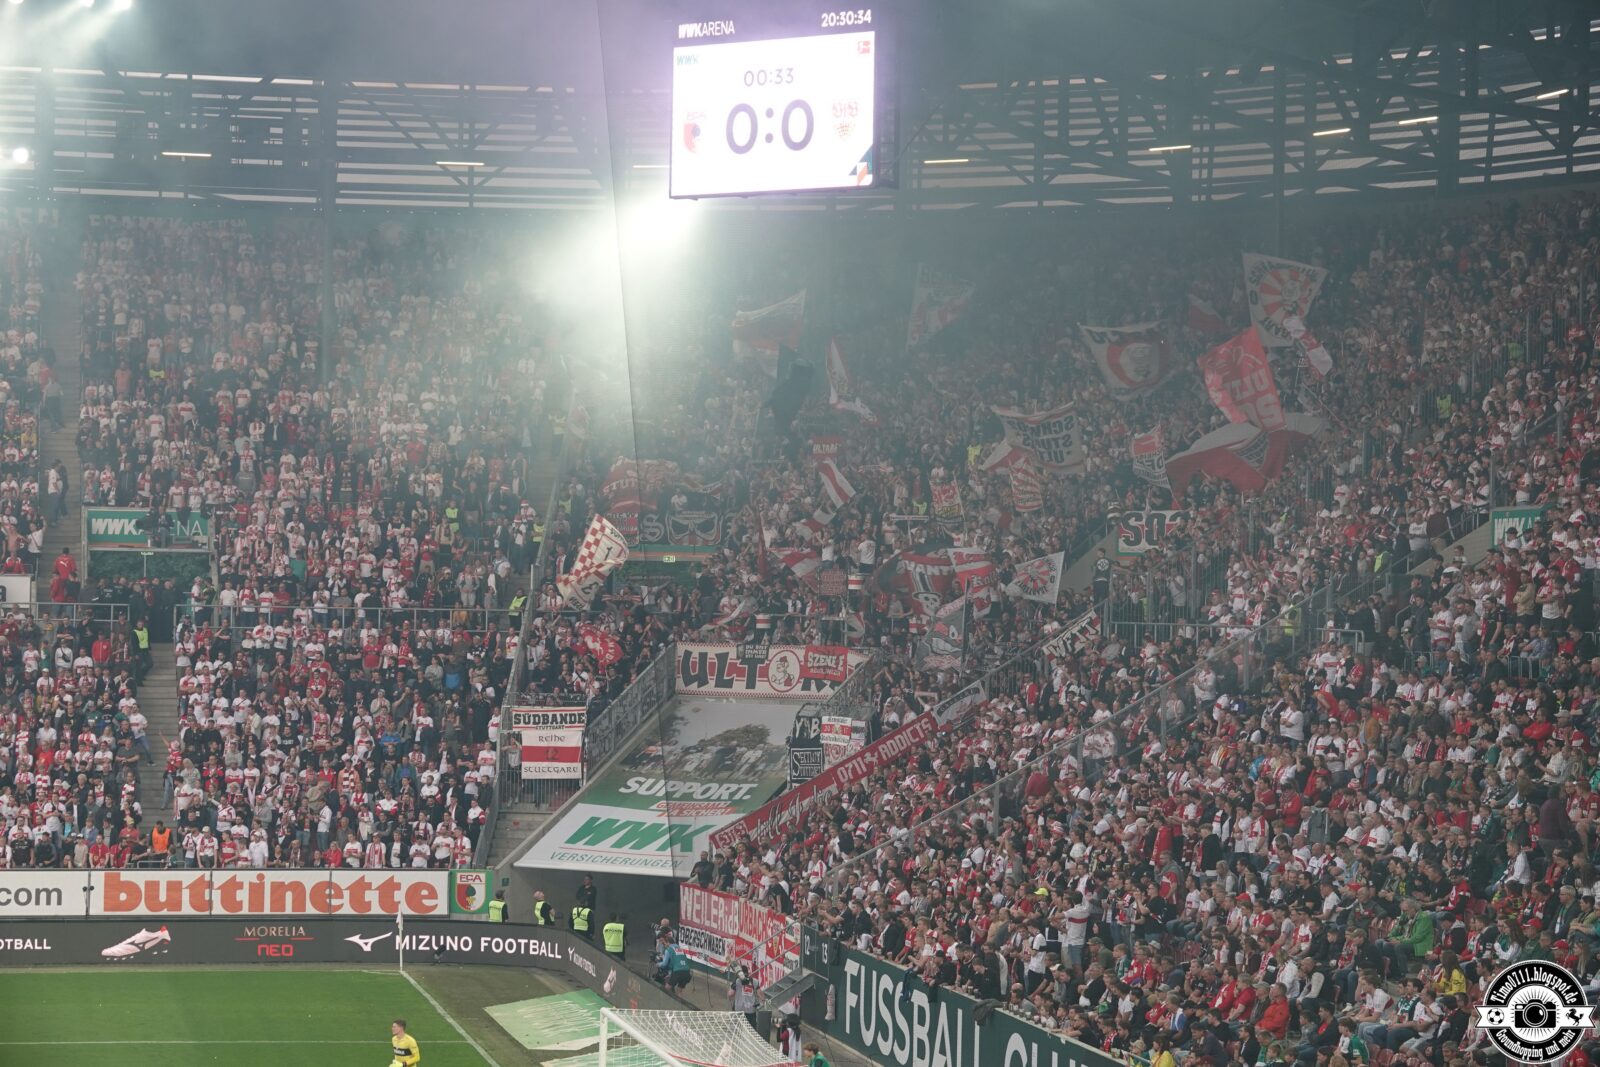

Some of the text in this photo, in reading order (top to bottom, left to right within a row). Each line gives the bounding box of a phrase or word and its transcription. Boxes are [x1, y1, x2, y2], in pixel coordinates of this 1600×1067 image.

[821, 9, 872, 27] 20:30:34
[743, 67, 794, 87] 00:33
[725, 98, 815, 155] 0:0
[513, 711, 585, 726] SÜDBANDE
[878, 716, 933, 763] ADDICTS
[618, 776, 758, 801] SUPPORT.
[564, 816, 718, 853] WWK
[550, 851, 683, 869] VERSICHERUNGEN
[103, 872, 440, 915] buttinette
[680, 886, 725, 931] WEILER
[243, 926, 306, 939] MORELIA
[679, 926, 726, 957] OBERSCHWABEN
[395, 934, 562, 959] MIZUNO FOOTBALL
